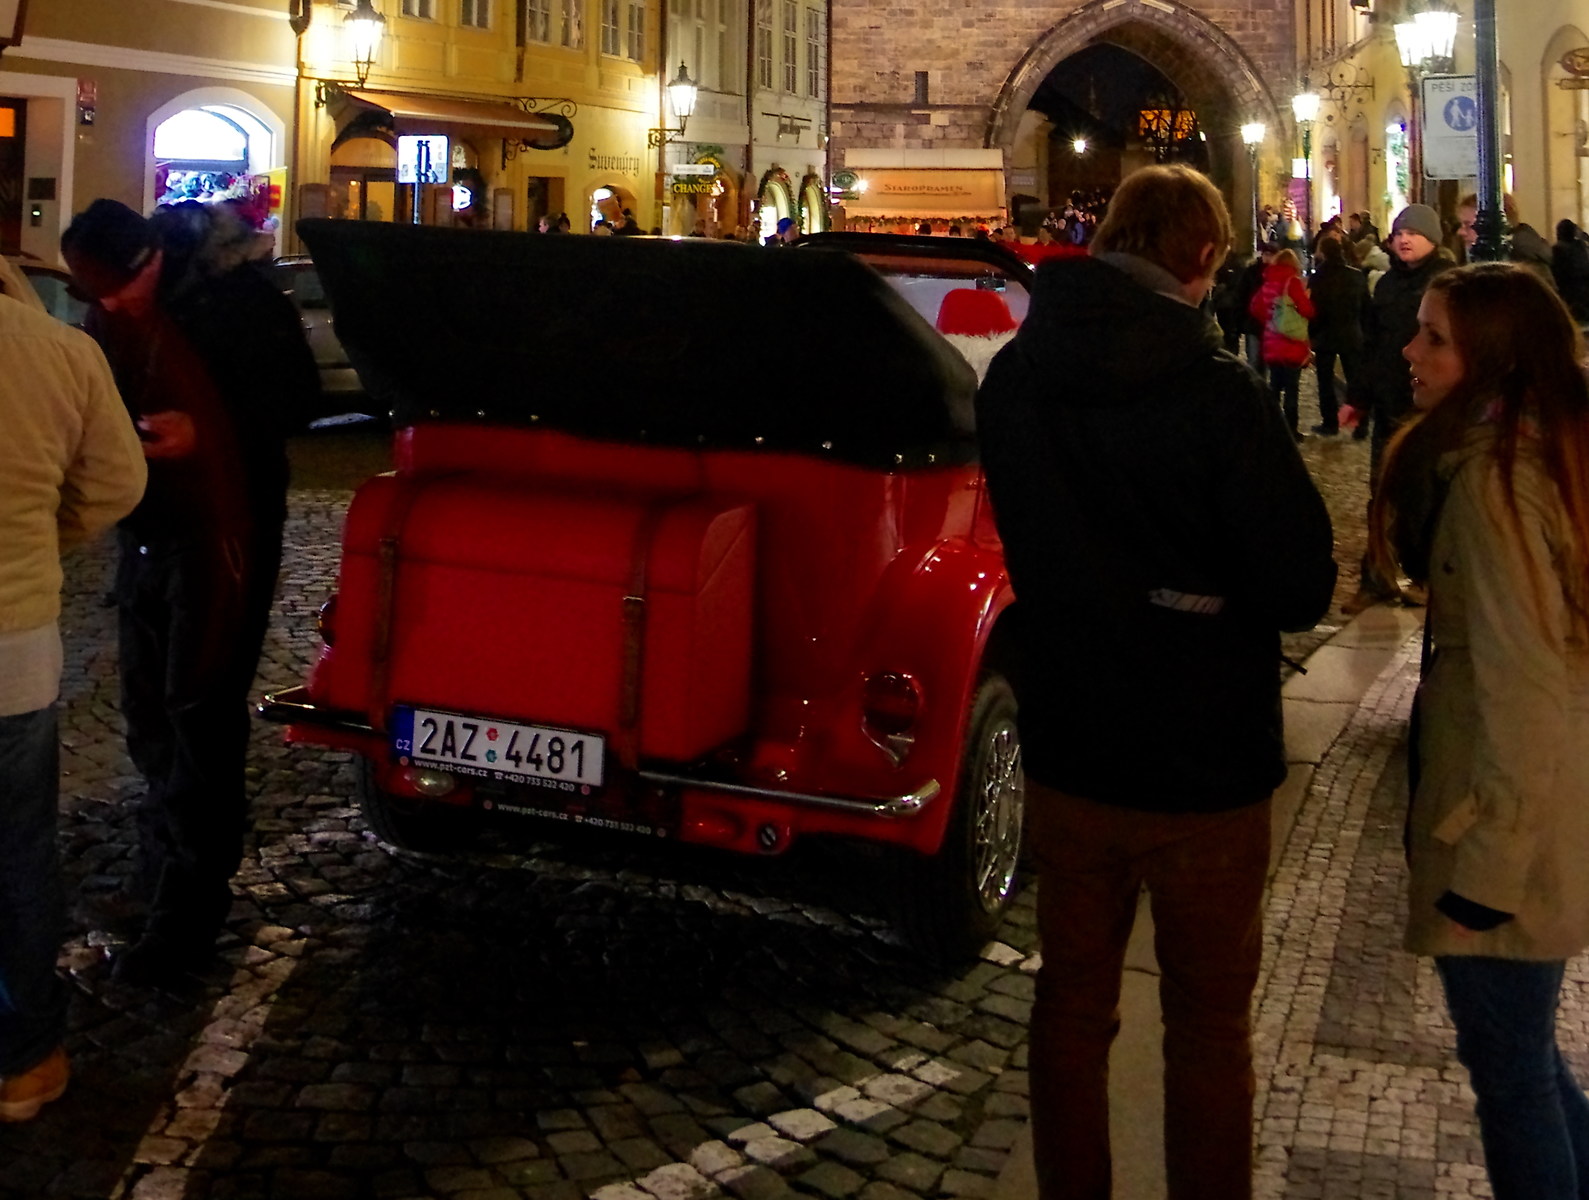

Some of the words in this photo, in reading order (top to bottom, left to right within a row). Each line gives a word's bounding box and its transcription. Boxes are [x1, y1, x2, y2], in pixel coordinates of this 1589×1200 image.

[395, 738, 411, 752] CZ
[419, 717, 479, 762] 2AZ
[505, 729, 585, 778] 4481
